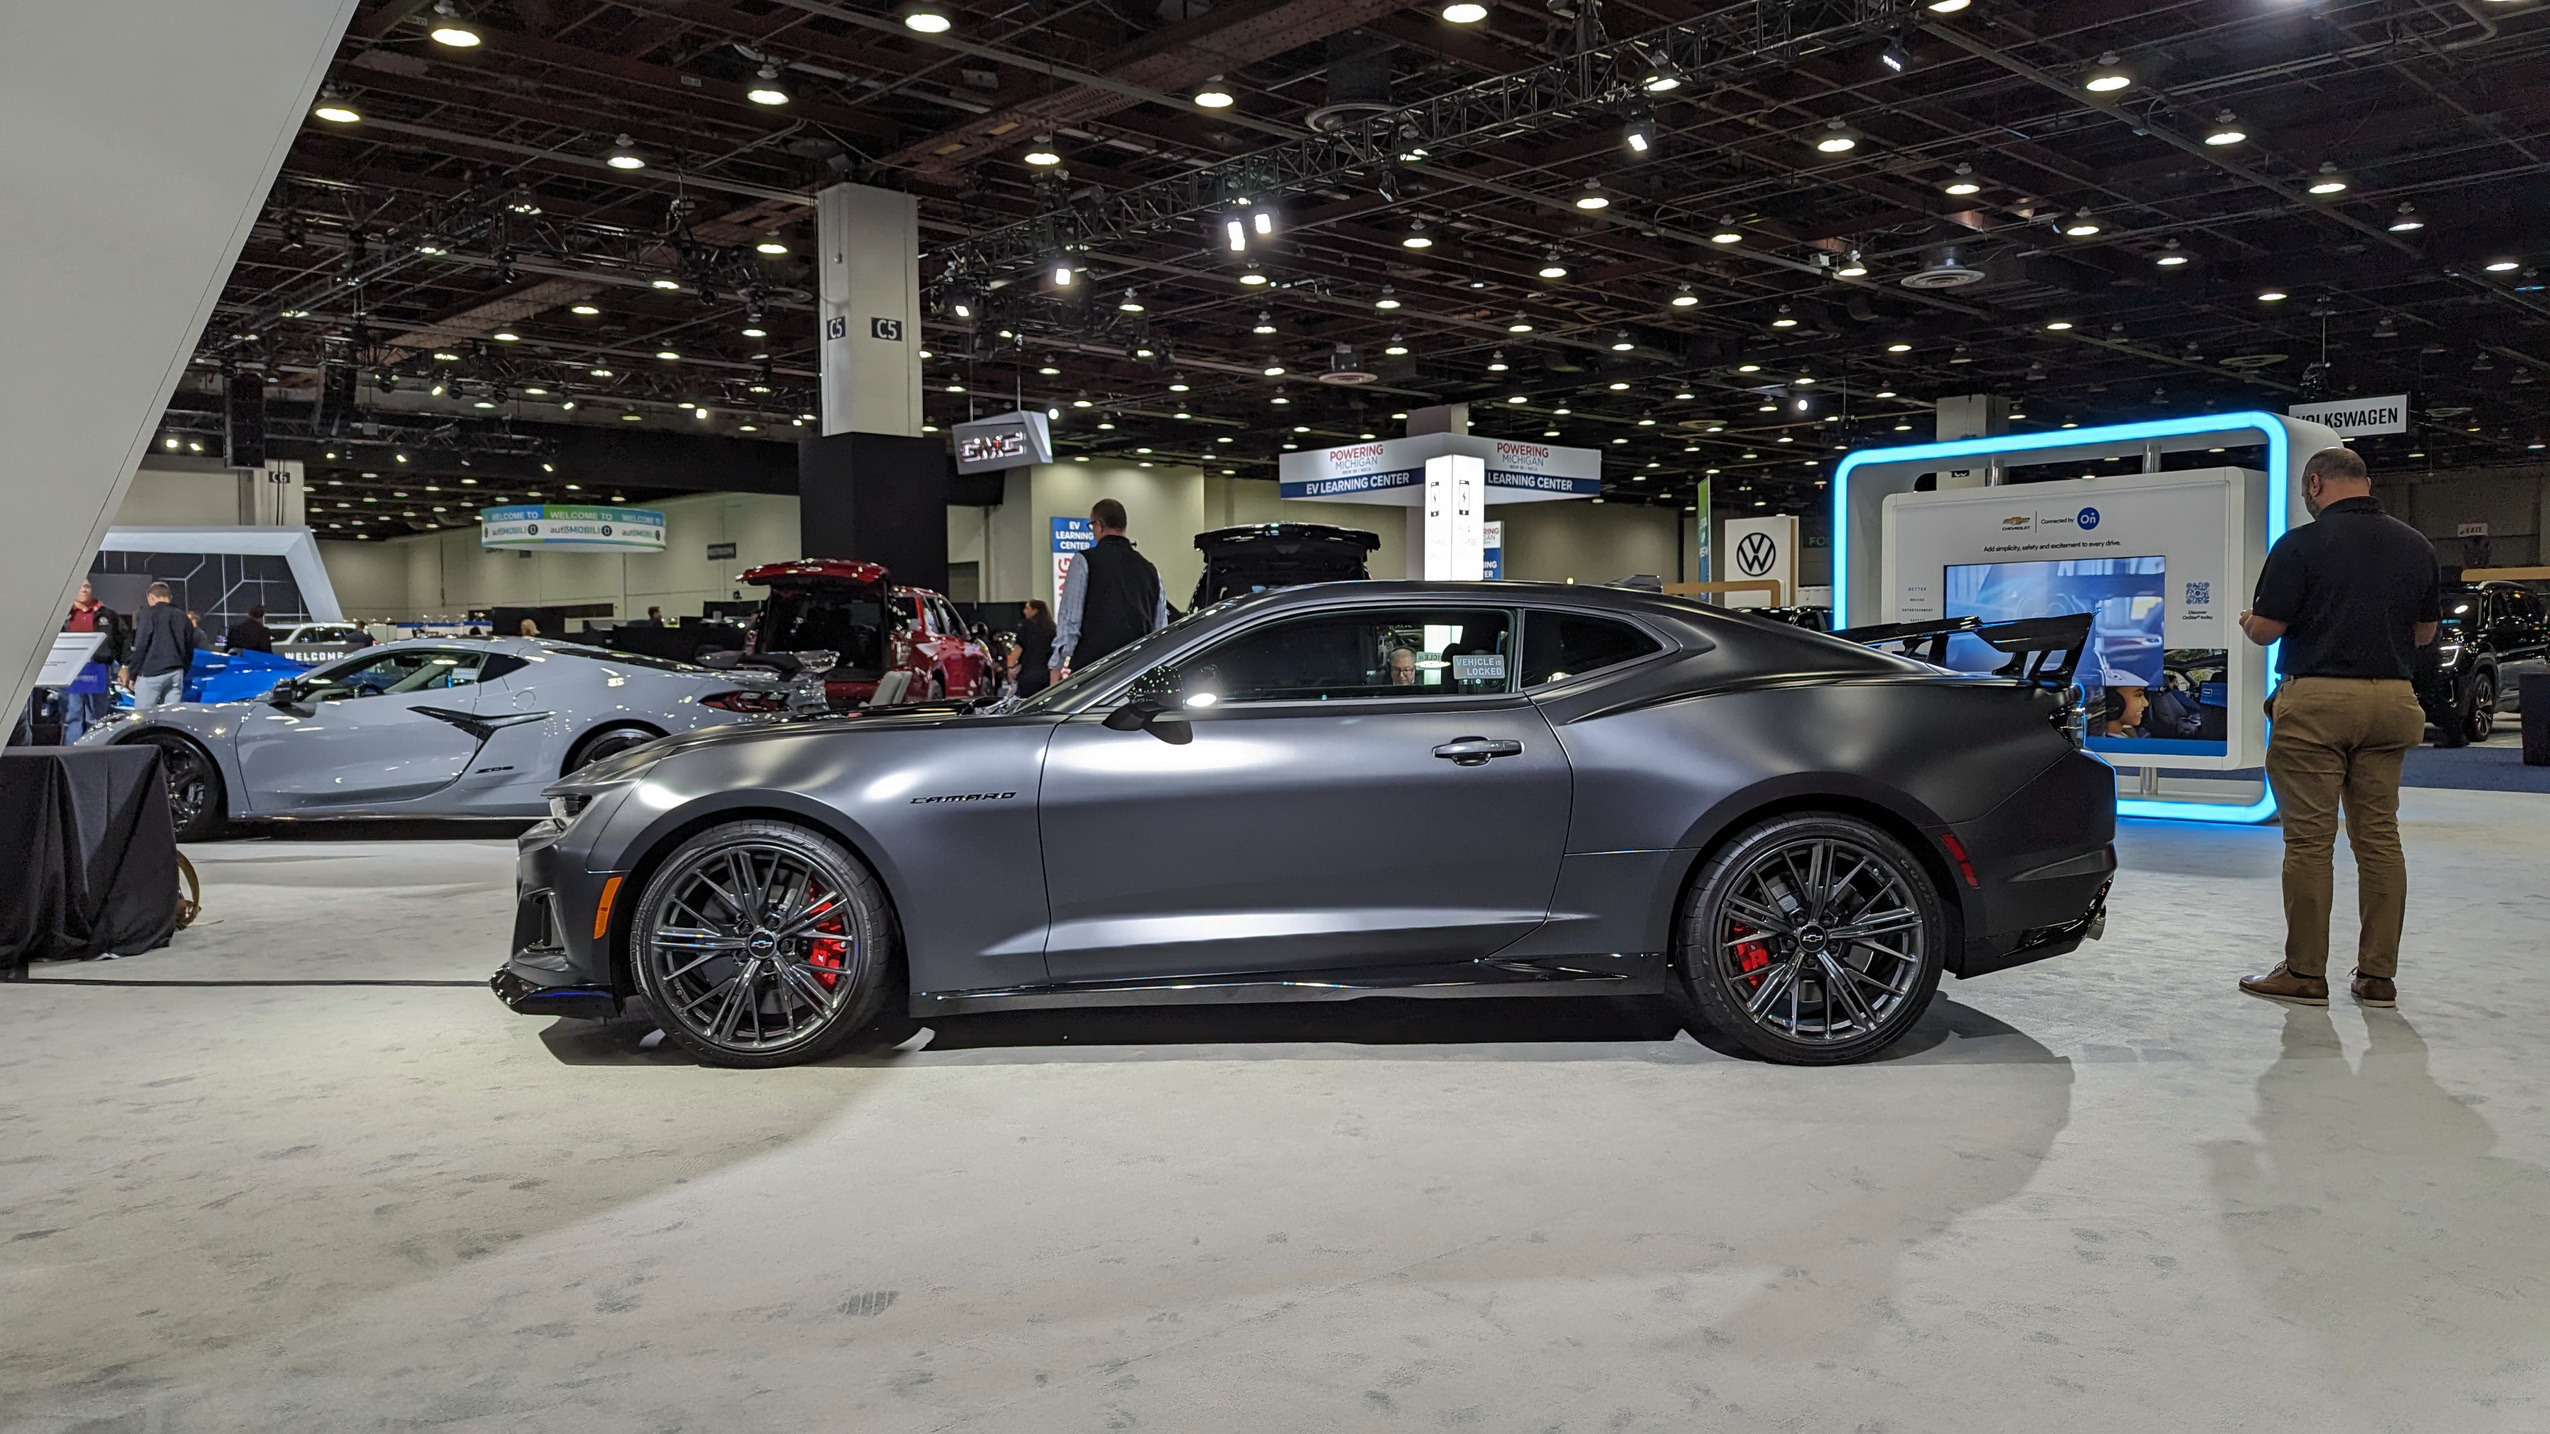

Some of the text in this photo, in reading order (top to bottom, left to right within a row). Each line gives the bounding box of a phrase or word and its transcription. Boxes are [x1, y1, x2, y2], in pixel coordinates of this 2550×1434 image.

[829, 318, 843, 339] C5
[877, 319, 897, 340] C5
[960, 431, 1023, 462] GMC
[1497, 442, 1549, 458] POWERING
[1330, 444, 1384, 462] POWERING
[1335, 456, 1378, 470] MICHIGAN
[1503, 454, 1543, 466] MICHIGAN
[272, 472, 288, 483] C6
[1306, 472, 1410, 495] EV LEARNING CENTER
[1487, 472, 1573, 491] LEARNING CENTER
[527, 511, 539, 519] TO
[550, 511, 598, 519] WELCOME
[1069, 521, 1080, 530] EV
[2465, 526, 2482, 534] EXIT
[1055, 530, 1094, 540] LEARNING
[1060, 541, 1090, 550] CENTER
[1996, 544, 2021, 552] simplicity,
[2050, 541, 2081, 549] excitement
[2105, 539, 2121, 547] drive.
[1456, 657, 1494, 666] VEHICLE
[1466, 668, 1503, 676] LOCKED
[910, 792, 1017, 804] CAMARO
